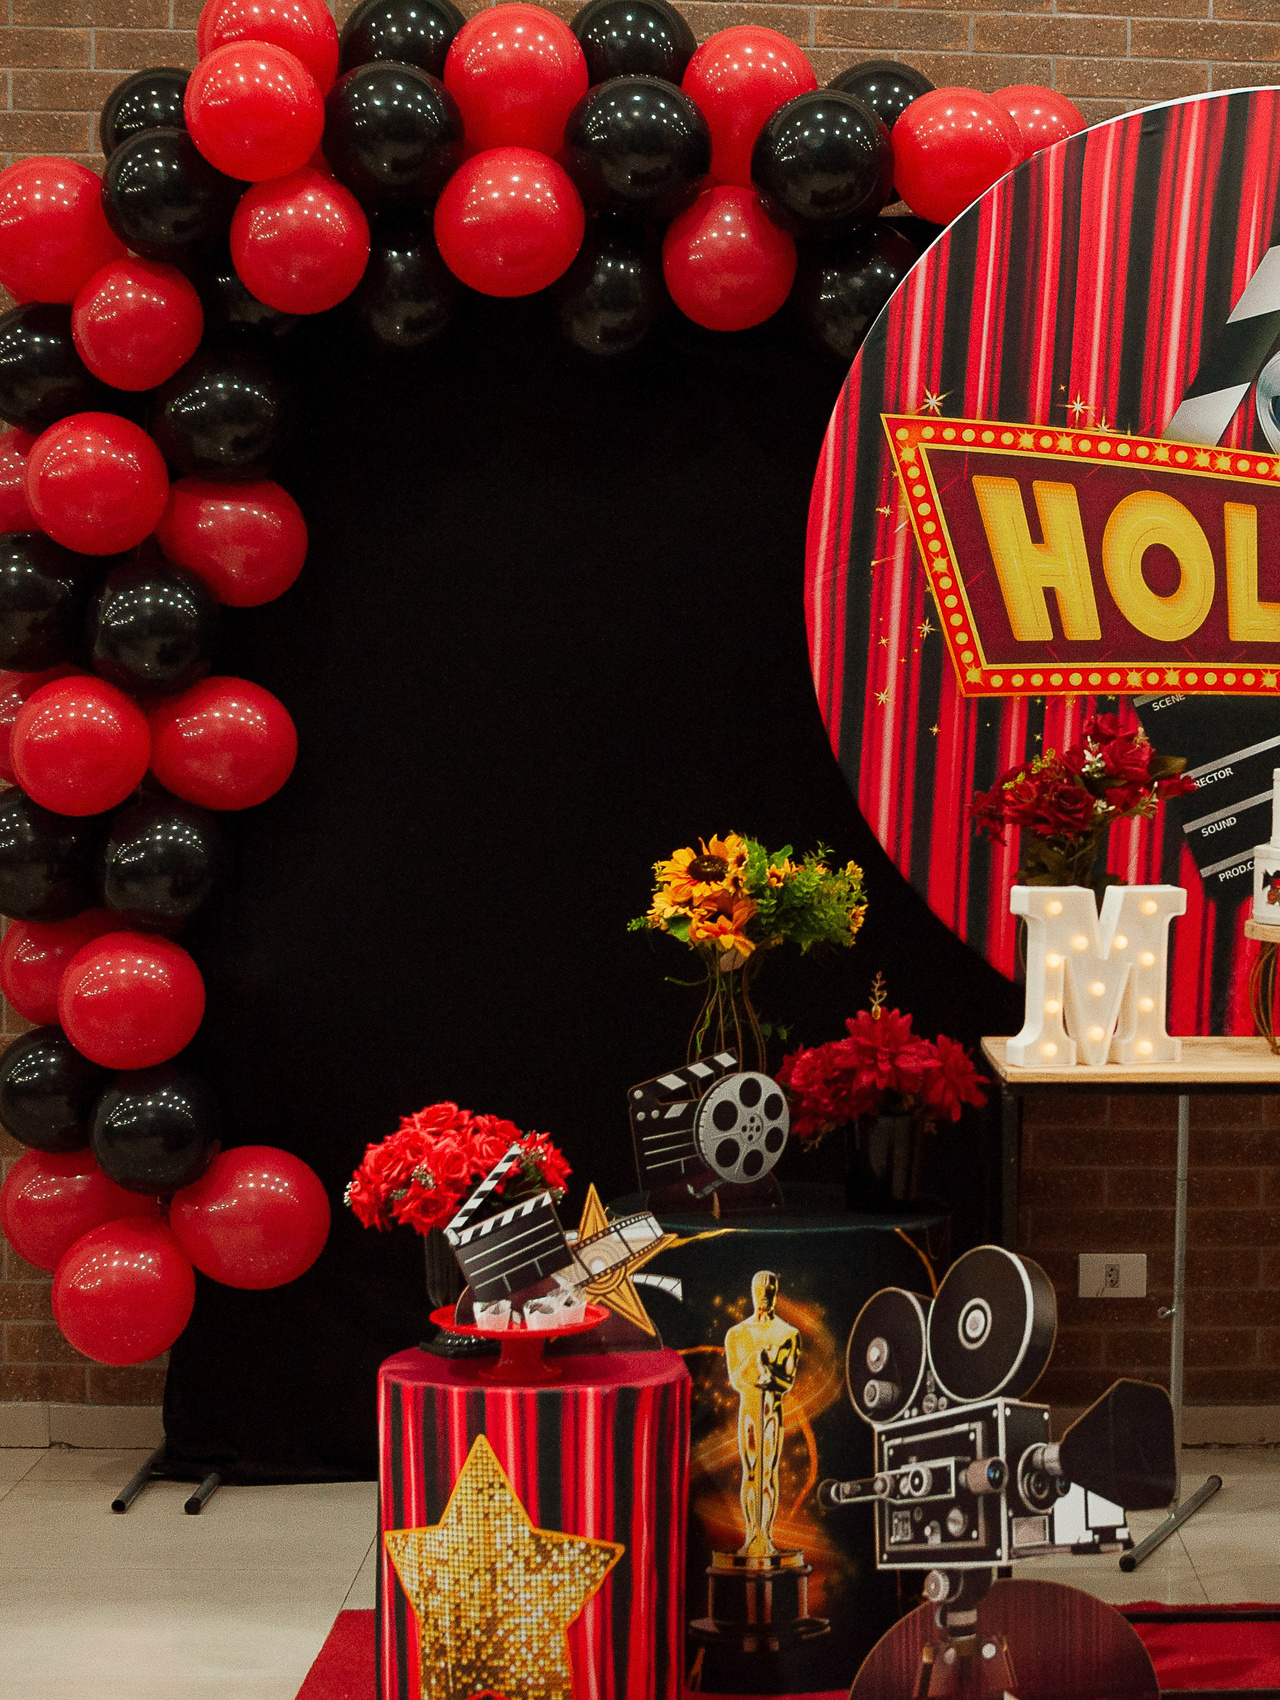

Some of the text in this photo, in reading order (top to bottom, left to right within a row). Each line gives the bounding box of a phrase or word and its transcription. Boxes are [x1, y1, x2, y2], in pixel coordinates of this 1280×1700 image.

[1152, 693, 1186, 711] SCENE
[1201, 816, 1237, 837] SOUND
[1006, 885, 1187, 1066] M
